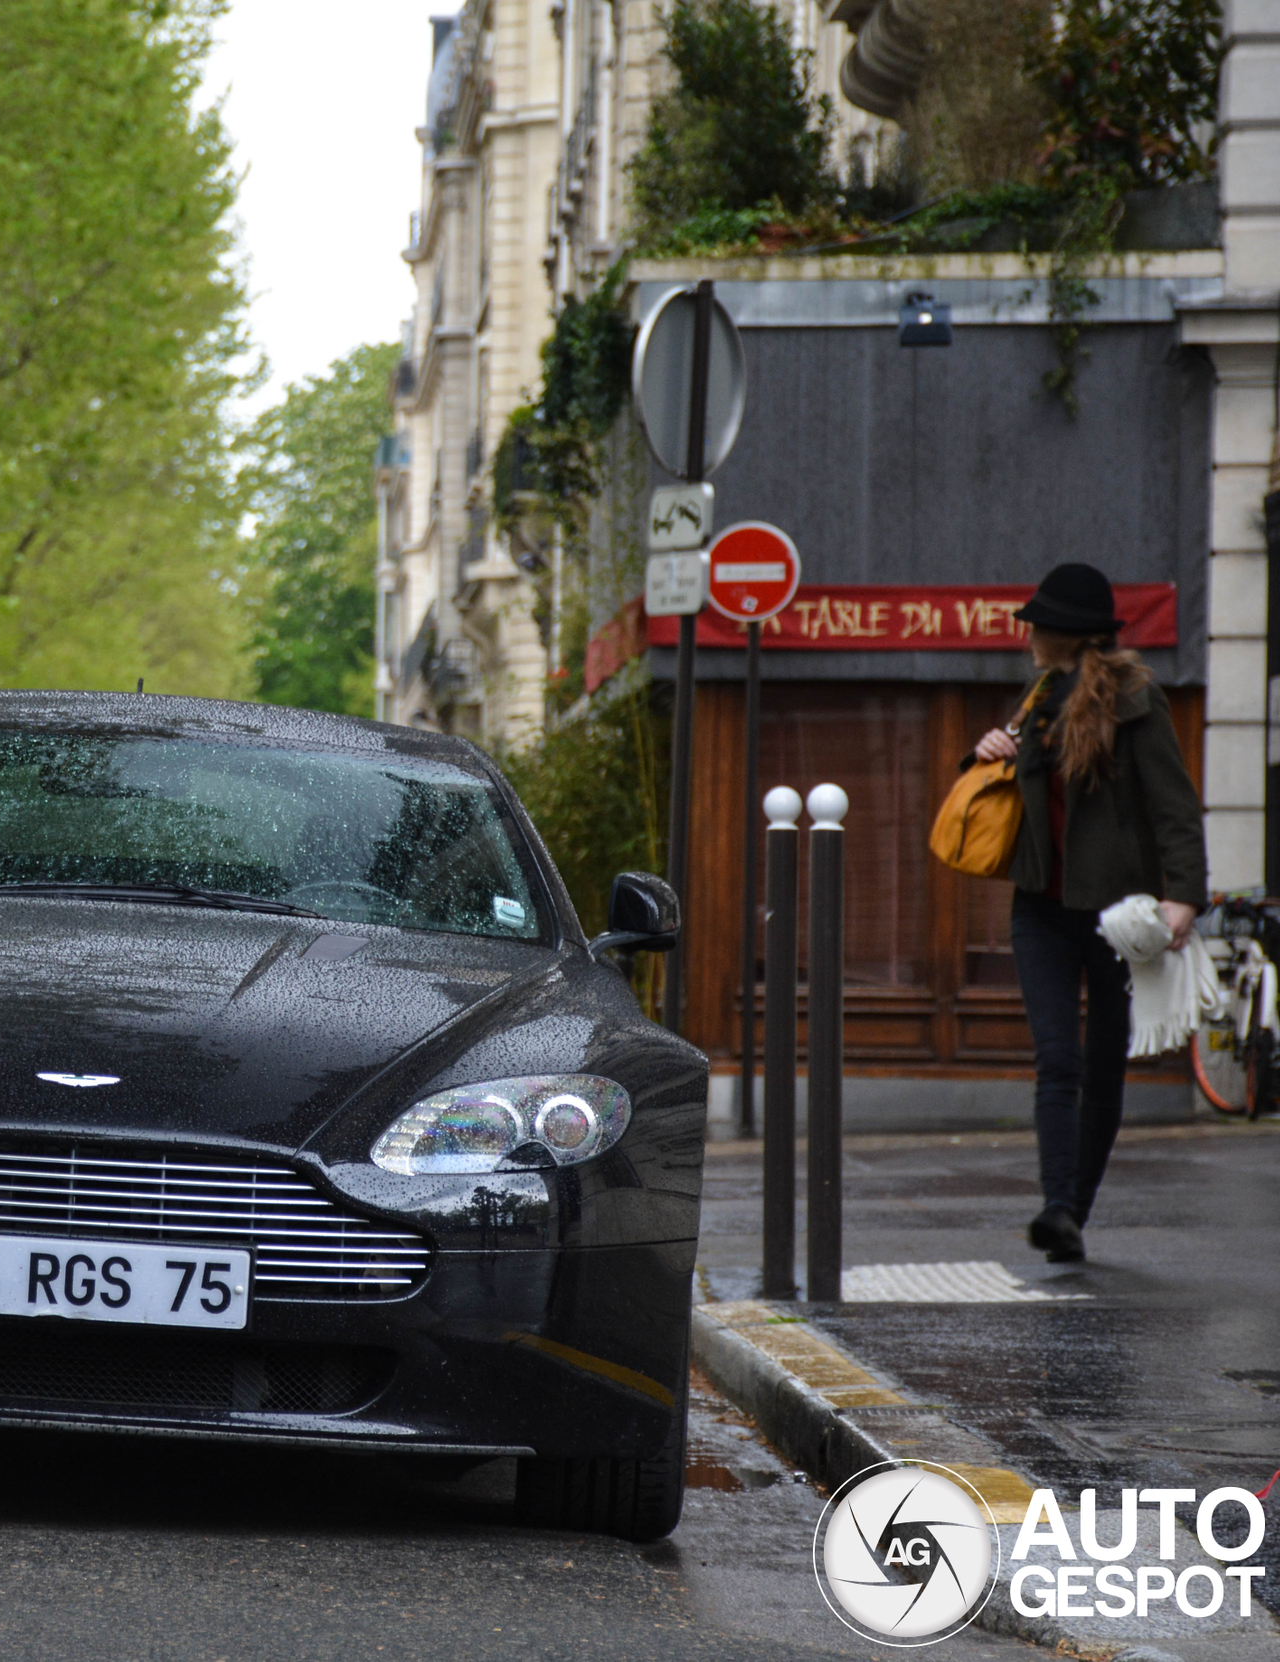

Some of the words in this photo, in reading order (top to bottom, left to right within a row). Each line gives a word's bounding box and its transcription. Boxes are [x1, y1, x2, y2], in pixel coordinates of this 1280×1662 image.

[793, 596, 891, 639] TABLE
[900, 600, 942, 638] DU
[27, 1251, 131, 1309] RGS
[165, 1260, 232, 1314] 75
